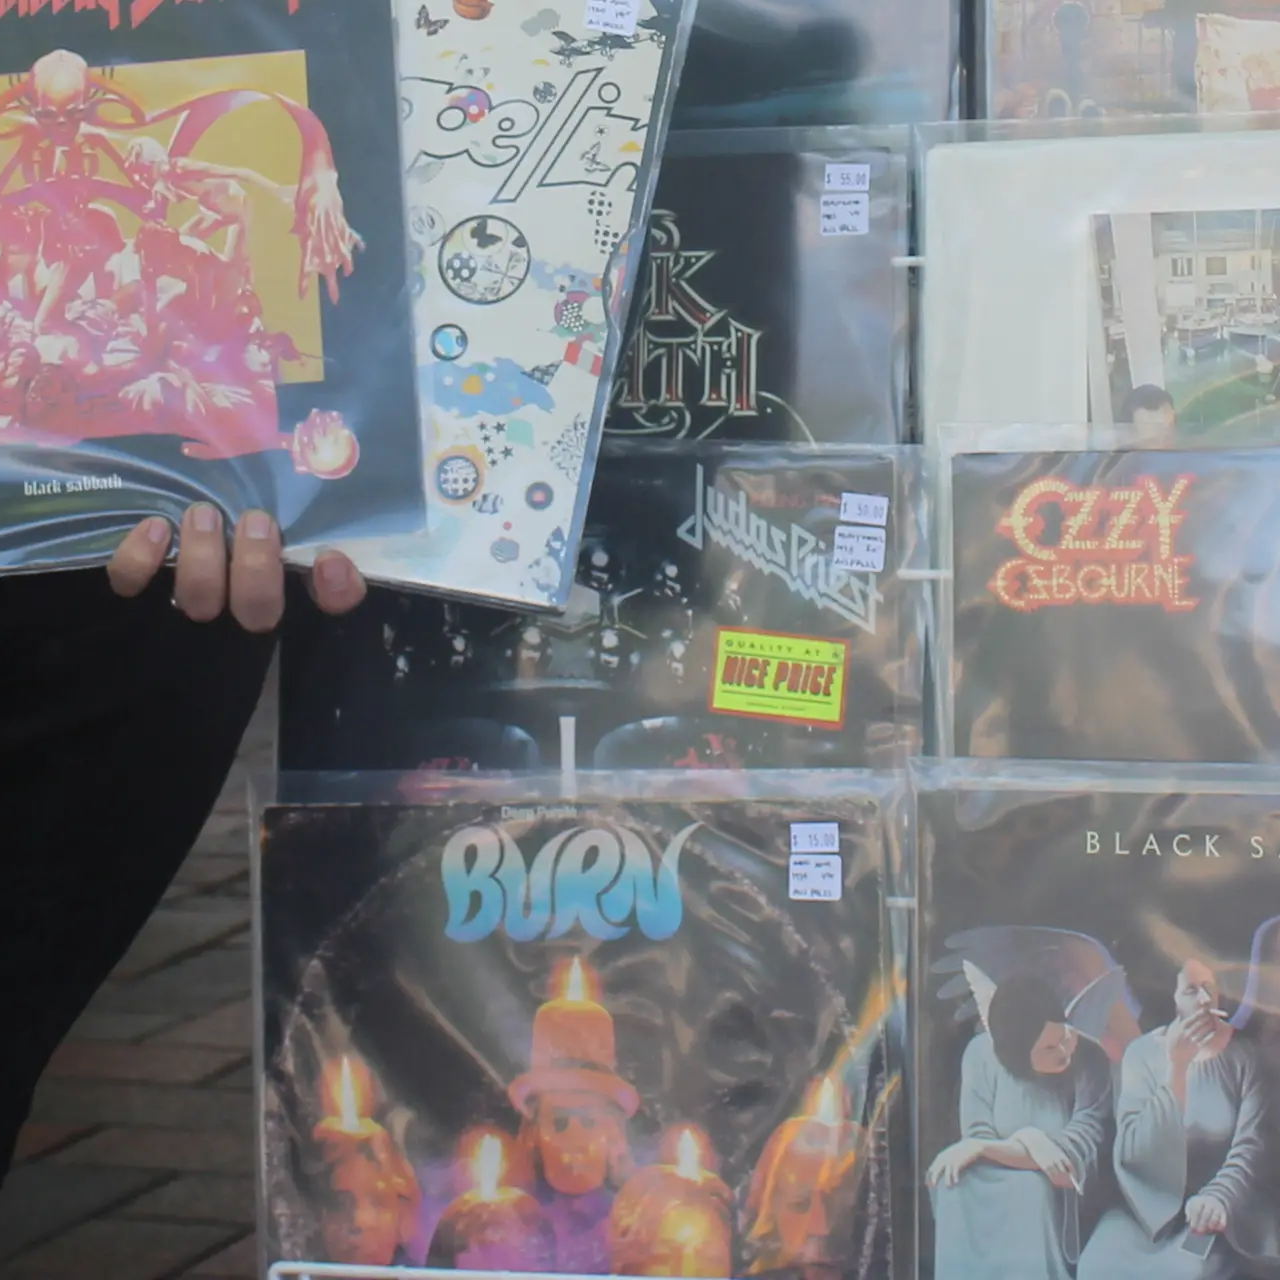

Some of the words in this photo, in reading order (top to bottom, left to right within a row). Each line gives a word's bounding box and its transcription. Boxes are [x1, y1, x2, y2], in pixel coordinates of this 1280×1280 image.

[23, 479, 62, 496] black
[66, 472, 123, 493] sabbath
[999, 475, 1194, 562] OZZY
[990, 556, 1198, 610] OSBOURNE
[725, 639, 793, 654] QUALITY
[804, 648, 821, 657] AT
[721, 655, 771, 690] NICE
[772, 660, 837, 698] PRICE
[1085, 830, 1222, 856] BLACK
[440, 820, 706, 943] BURN
